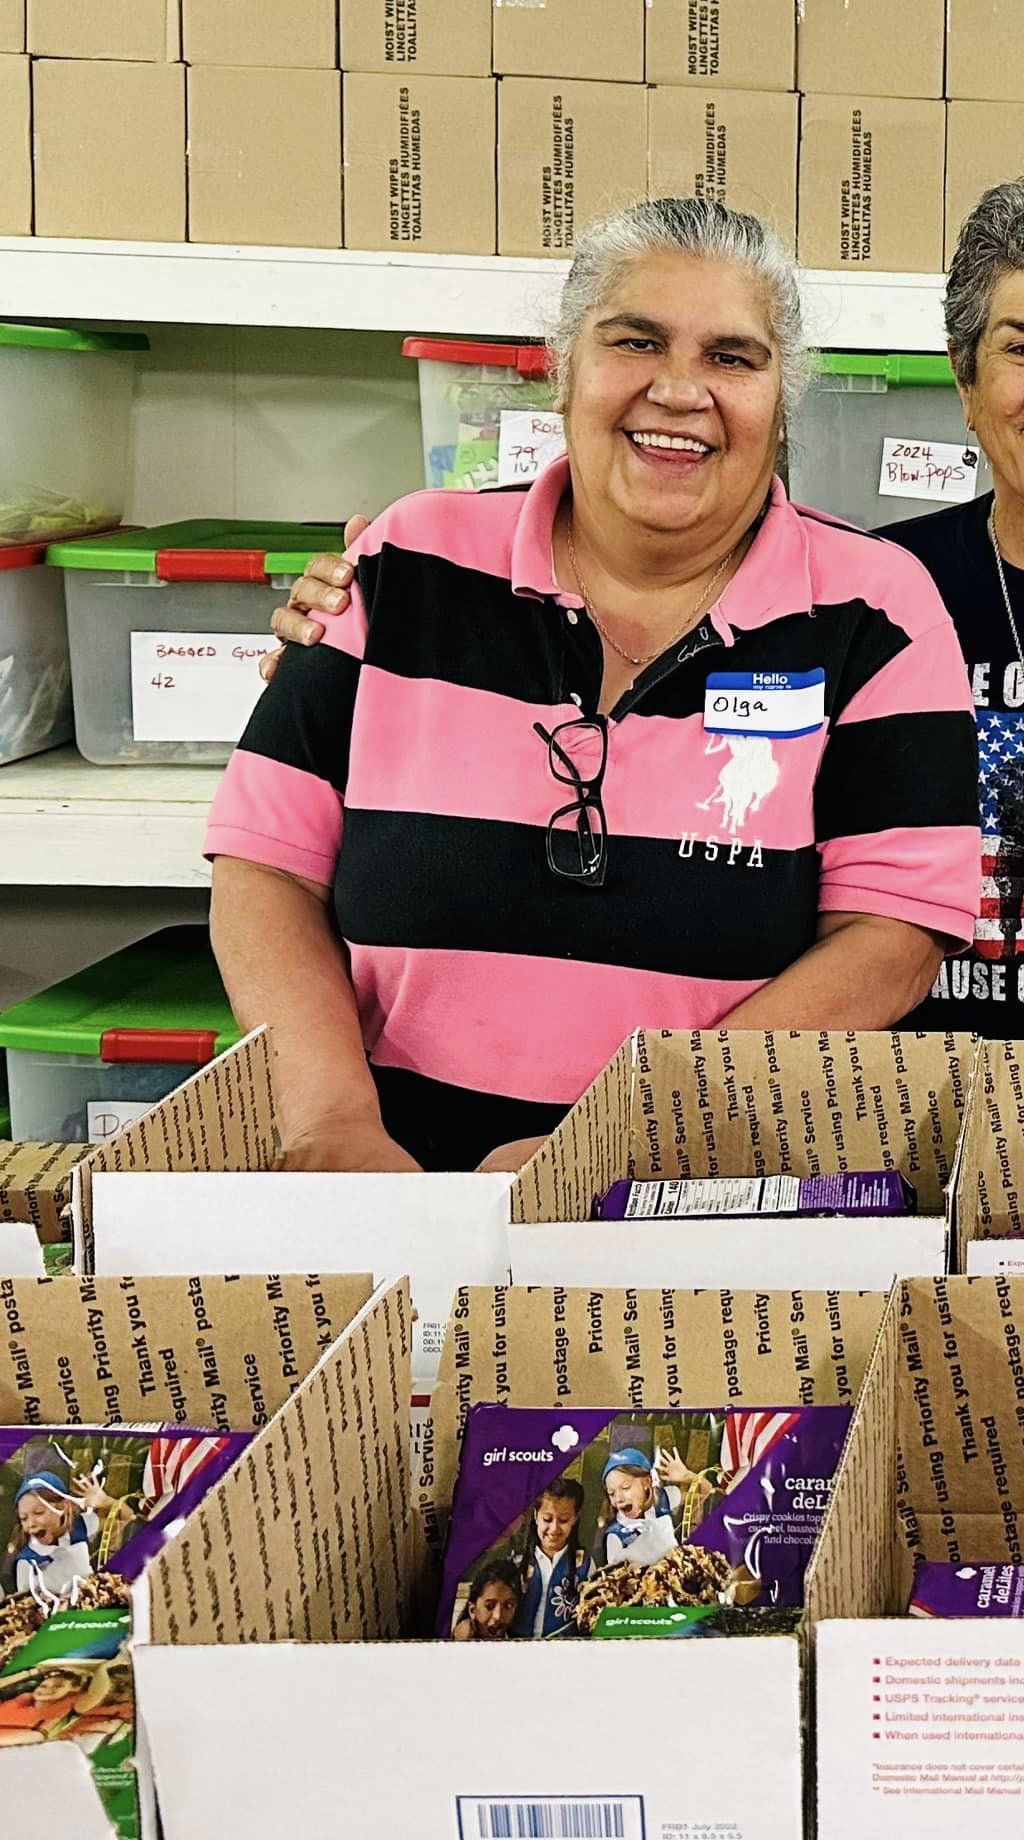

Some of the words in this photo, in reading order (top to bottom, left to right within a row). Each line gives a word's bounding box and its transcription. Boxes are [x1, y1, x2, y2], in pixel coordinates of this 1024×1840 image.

[385, 21, 394, 61] MOIST
[396, 0, 405, 61] LINGETTE
[407, 0, 416, 62] TOALLITA
[699, 5, 708, 75] LINGETTES
[710, 8, 719, 76] TOALLITAS
[688, 34, 697, 75] MOIST
[411, 109, 421, 170] HUMEDAS
[390, 159, 398, 199] WIPES
[862, 131, 872, 191] HUMEDAS
[400, 172, 410, 240] LINGETTES
[412, 175, 421, 241] TOALLITAS
[842, 180, 850, 219] WIPES
[390, 202, 399, 240] MOIST
[841, 222, 850, 260] MOIST
[852, 191, 861, 260] LINGETTES
[862, 195, 872, 260] TOALLITAS
[892, 445, 933, 459] 2024
[150, 673, 175, 690] 42
[753, 673, 788, 685] Hello
[712, 696, 768, 717] Olga
[678, 832, 764, 868] USPA
[931, 962, 1005, 1001] AUSE
[721, 1046, 735, 1072] you
[694, 1056, 709, 1109] Priority
[724, 1076, 739, 1121] Thank
[1009, 1063, 1023, 1101] using
[672, 1090, 686, 1144] Service
[702, 1112, 715, 1151] using
[742, 1085, 760, 1146] required
[646, 1119, 662, 1172] Priority
[708, 1156, 719, 1177] for
[126, 1295, 147, 1329] you
[88, 1309, 112, 1380] Priority
[132, 1335, 156, 1397] Thank
[483, 1447, 507, 1467] girl
[509, 1449, 554, 1462] scouts
[976, 1566, 997, 1609] caramel
[48, 1620, 73, 1631] girl
[74, 1620, 119, 1630] scouts
[605, 1617, 628, 1627] girl
[630, 1617, 673, 1627] scouts
[885, 1657, 942, 1668] Expected
[945, 1657, 991, 1668] delivery
[885, 1676, 942, 1686] Domestic
[944, 1676, 1006, 1687] shipments
[885, 1712, 928, 1722] Limited
[932, 1712, 1005, 1722] international
